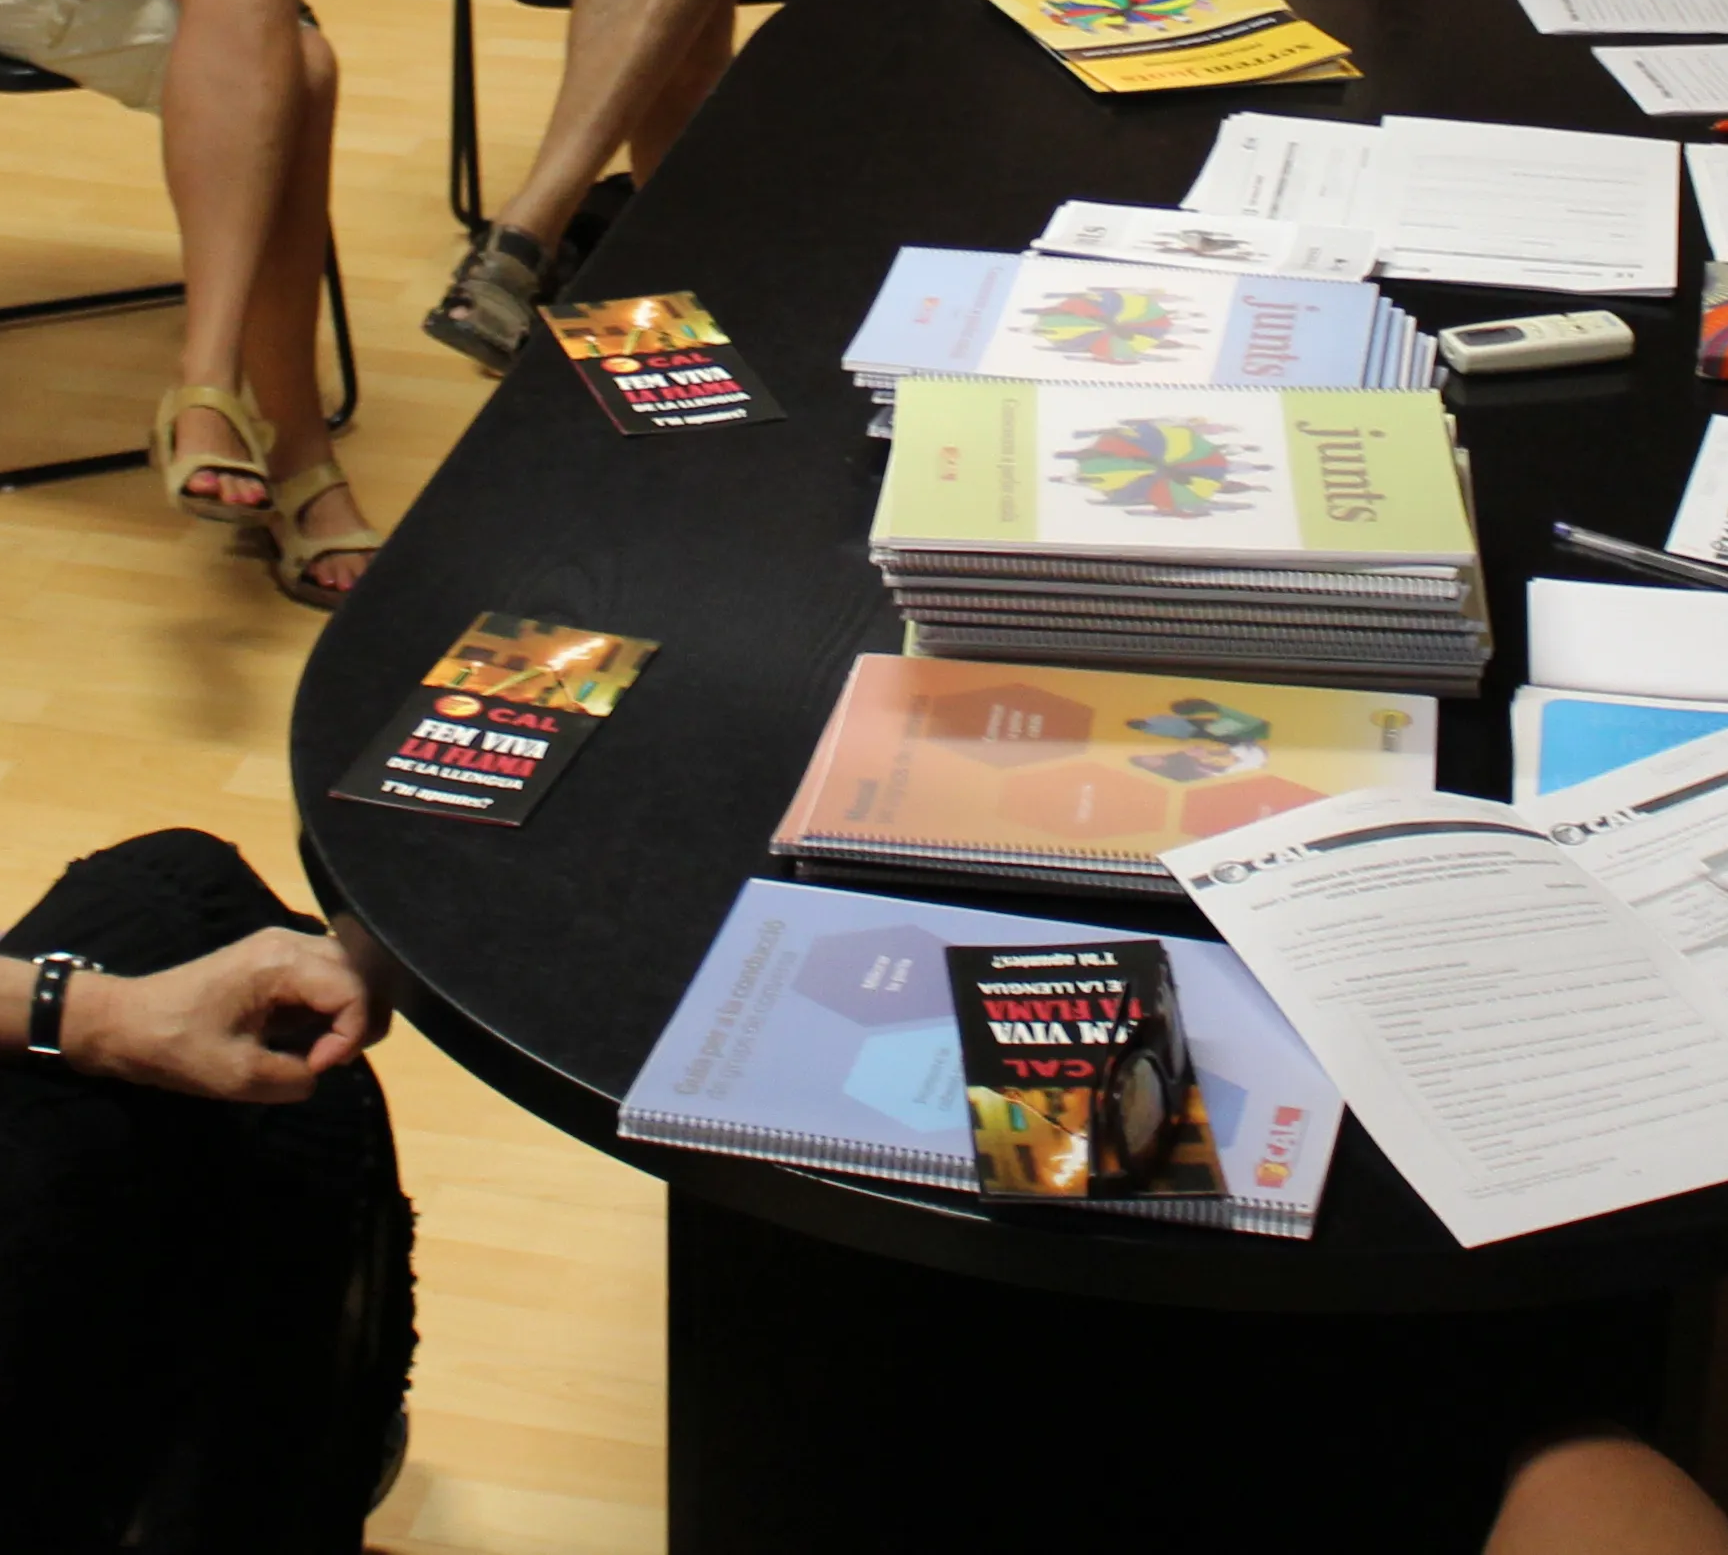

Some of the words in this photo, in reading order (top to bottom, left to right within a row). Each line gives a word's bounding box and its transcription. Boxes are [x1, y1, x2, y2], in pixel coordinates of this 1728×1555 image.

[1242, 295, 1320, 379] junts
[646, 352, 715, 367] CAL
[612, 372, 670, 391] FEM
[668, 365, 733, 386] VIVA
[1294, 417, 1387, 525] junts
[487, 707, 560, 733] CAL
[411, 718, 482, 747] FEM
[480, 730, 551, 760] VIVA
[397, 736, 440, 761] LA
[439, 745, 538, 778] FLAMA
[439, 766, 526, 791] LLENGUA
[1254, 842, 1323, 870] CAL
[976, 981, 1076, 996] LLENGUA
[1075, 979, 1106, 995] LA
[982, 998, 1094, 1021] FLAMA
[987, 1020, 1074, 1045] VIVA
[1001, 1058, 1097, 1078] CAL
[1267, 1120, 1303, 1163] CAL
